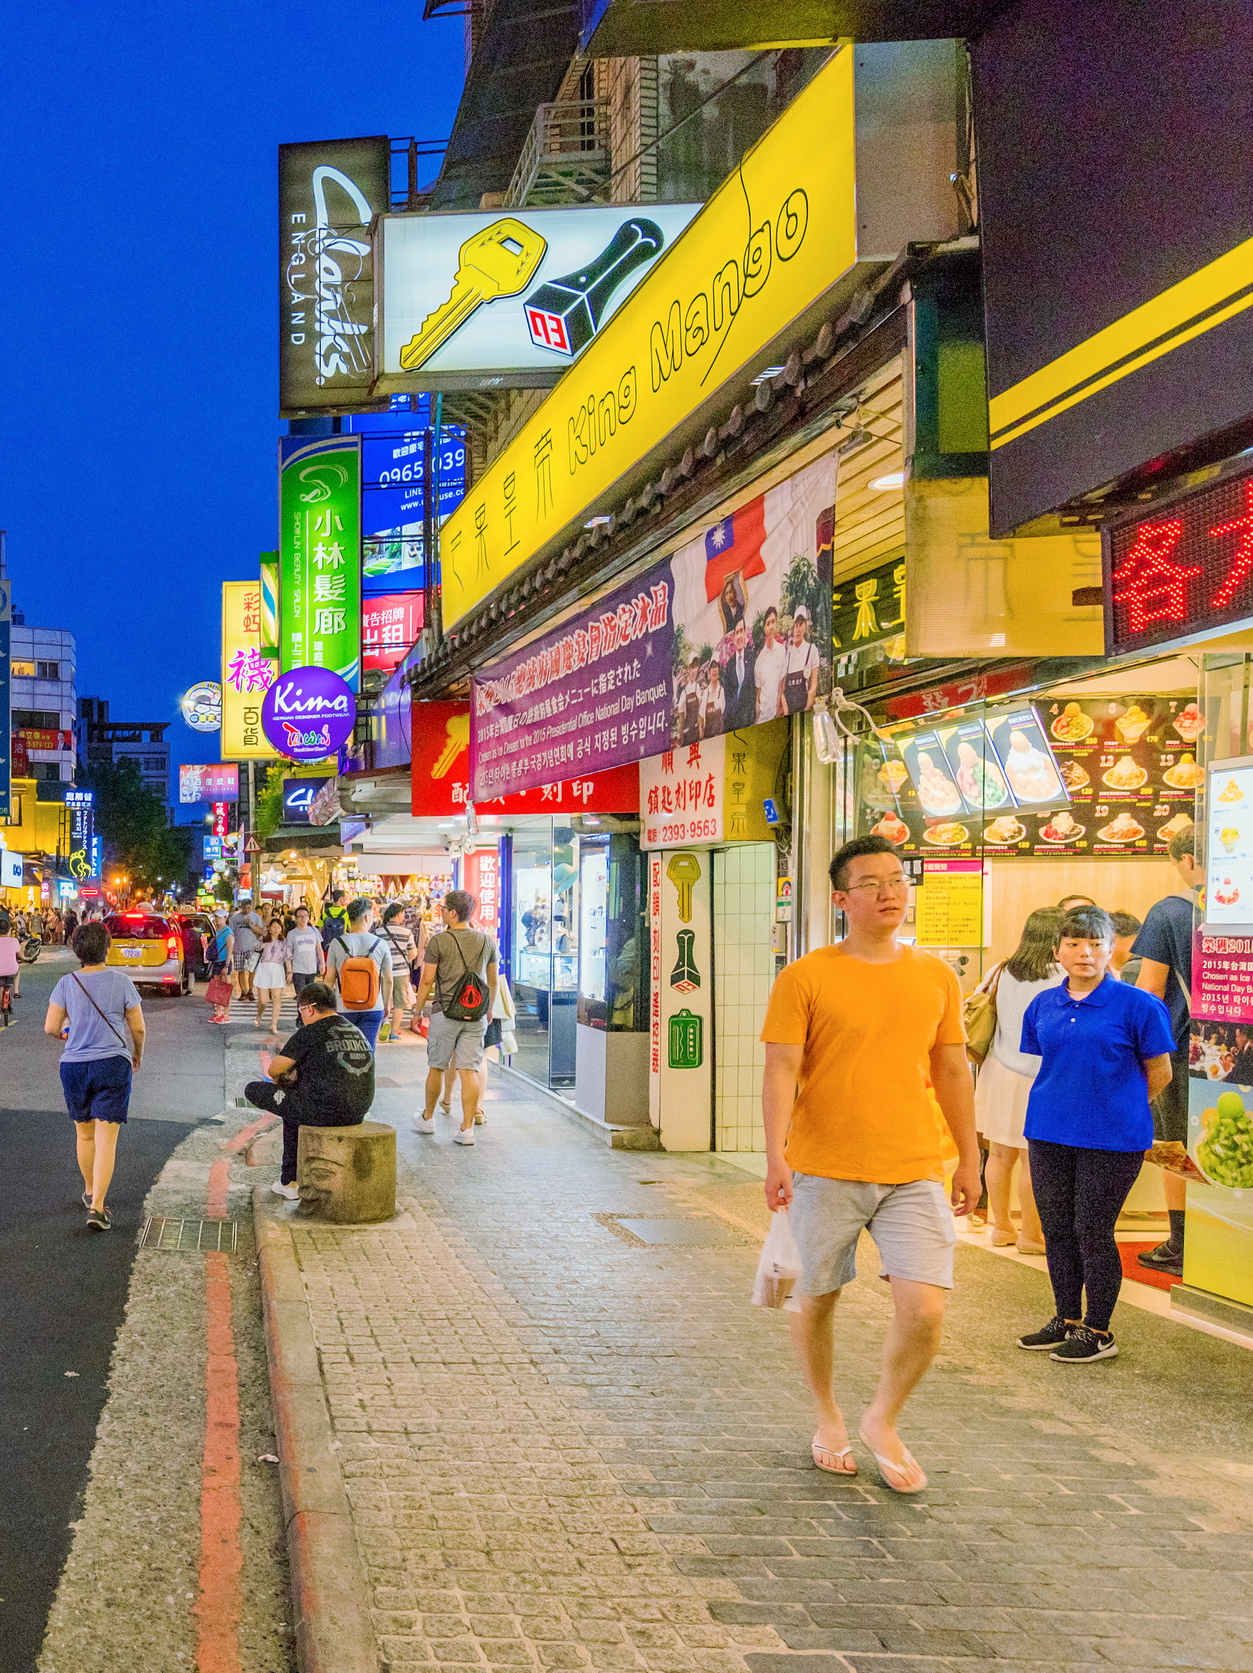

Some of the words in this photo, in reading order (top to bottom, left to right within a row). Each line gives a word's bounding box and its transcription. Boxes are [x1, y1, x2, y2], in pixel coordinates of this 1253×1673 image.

[290, 213, 306, 347] ENGLAND
[312, 163, 372, 383] Clarks
[568, 363, 638, 476] King
[649, 187, 809, 390] Mango
[313, 508, 346, 636] 小林髮廊
[274, 682, 347, 713] Kimo
[595, 692, 620, 721] National
[620, 686, 635, 715] Day
[635, 680, 668, 708] Banquet
[242, 706, 260, 747] 百貨
[1099, 756, 1115, 767] 12
[647, 772, 716, 816] 鎖匙刻印店
[730, 731, 748, 834] 果皇帝
[1153, 805, 1170, 816] 20
[479, 855, 496, 921] 歡迎使用
[1201, 937, 1253, 954] 榮獲201
[1202, 971, 1228, 981] Chosen
[1240, 974, 1250, 982] Ice
[1202, 983, 1229, 992] National
[1231, 984, 1245, 994] Day
[1202, 1004, 1244, 1015] 빙수입니다.
